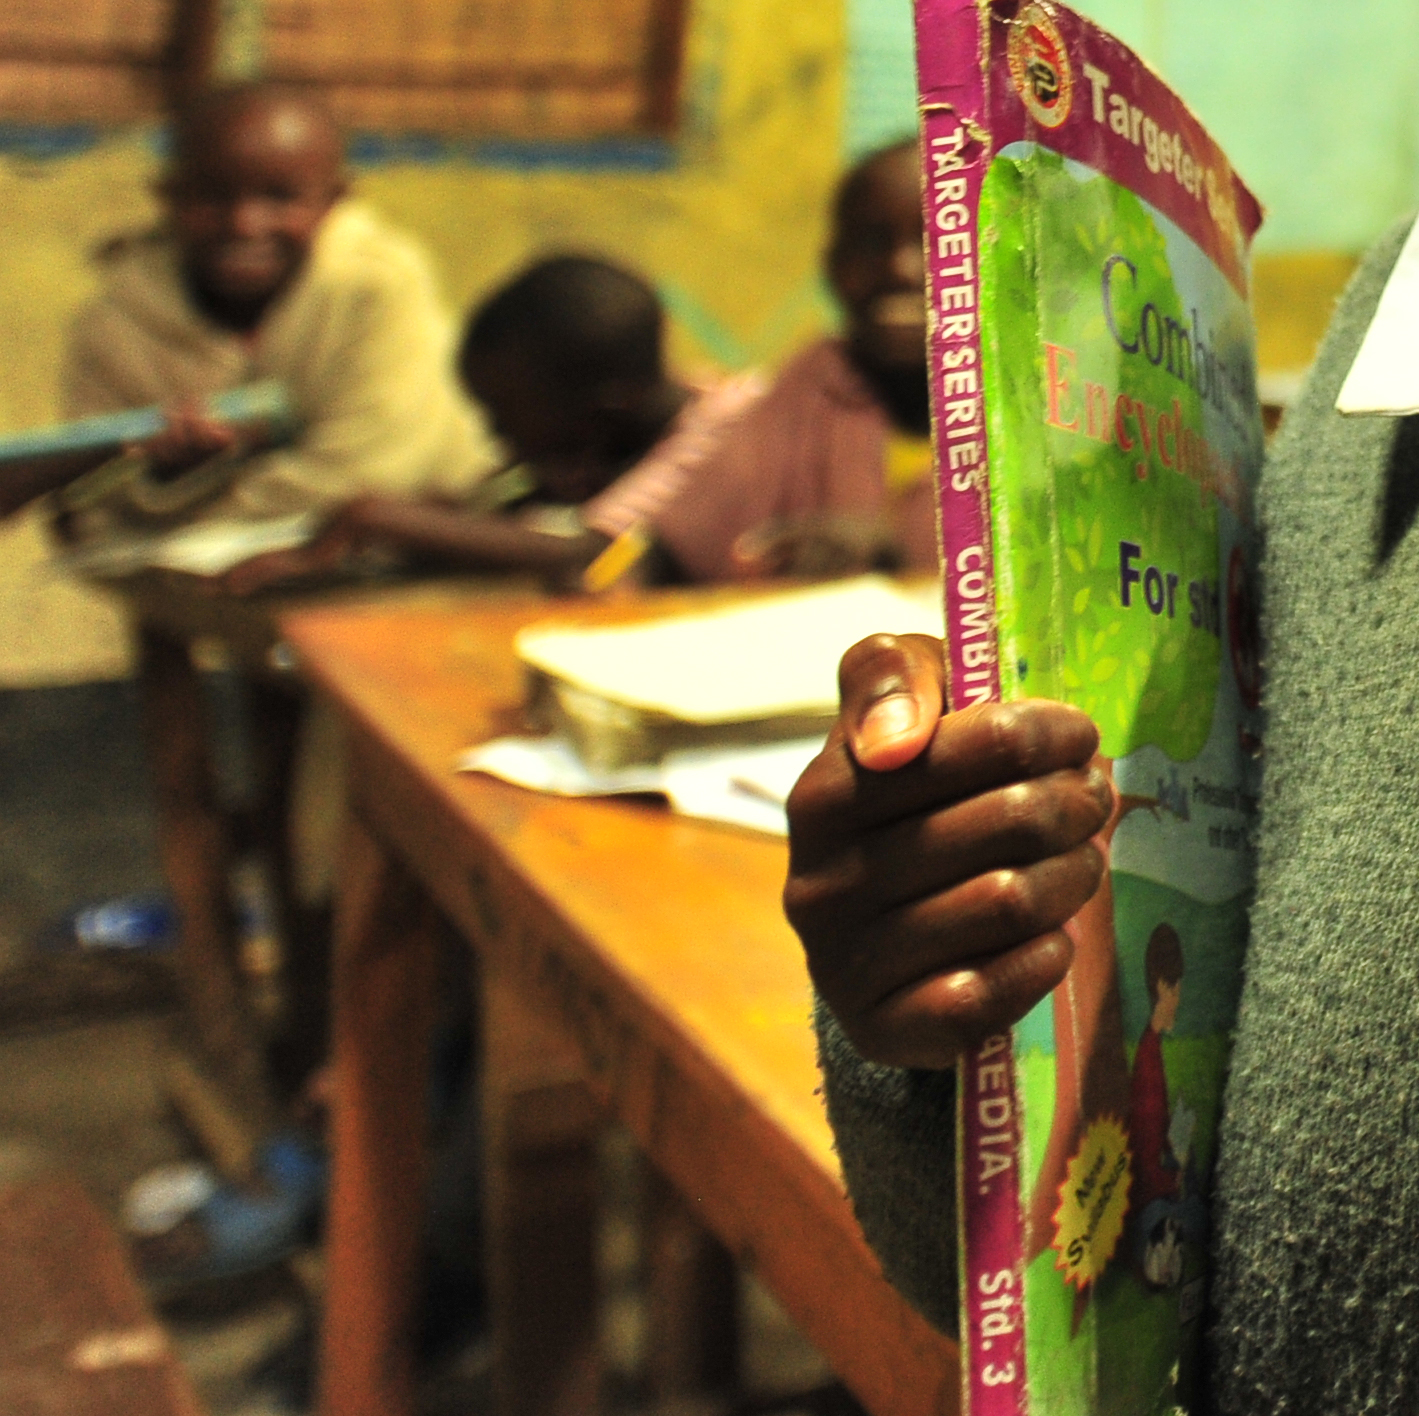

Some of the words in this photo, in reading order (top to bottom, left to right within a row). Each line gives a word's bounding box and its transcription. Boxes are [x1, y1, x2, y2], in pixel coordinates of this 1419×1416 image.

[1082, 61, 1204, 199] Targeter
[932, 127, 977, 340] TARGETER
[941, 345, 982, 492] SERIES
[955, 546, 996, 704] COMBIN
[1119, 540, 1179, 619] For
[977, 1035, 1013, 1195] AEDIA.
[978, 1269, 1017, 1351] Std.
[981, 1360, 1017, 1388] 3
